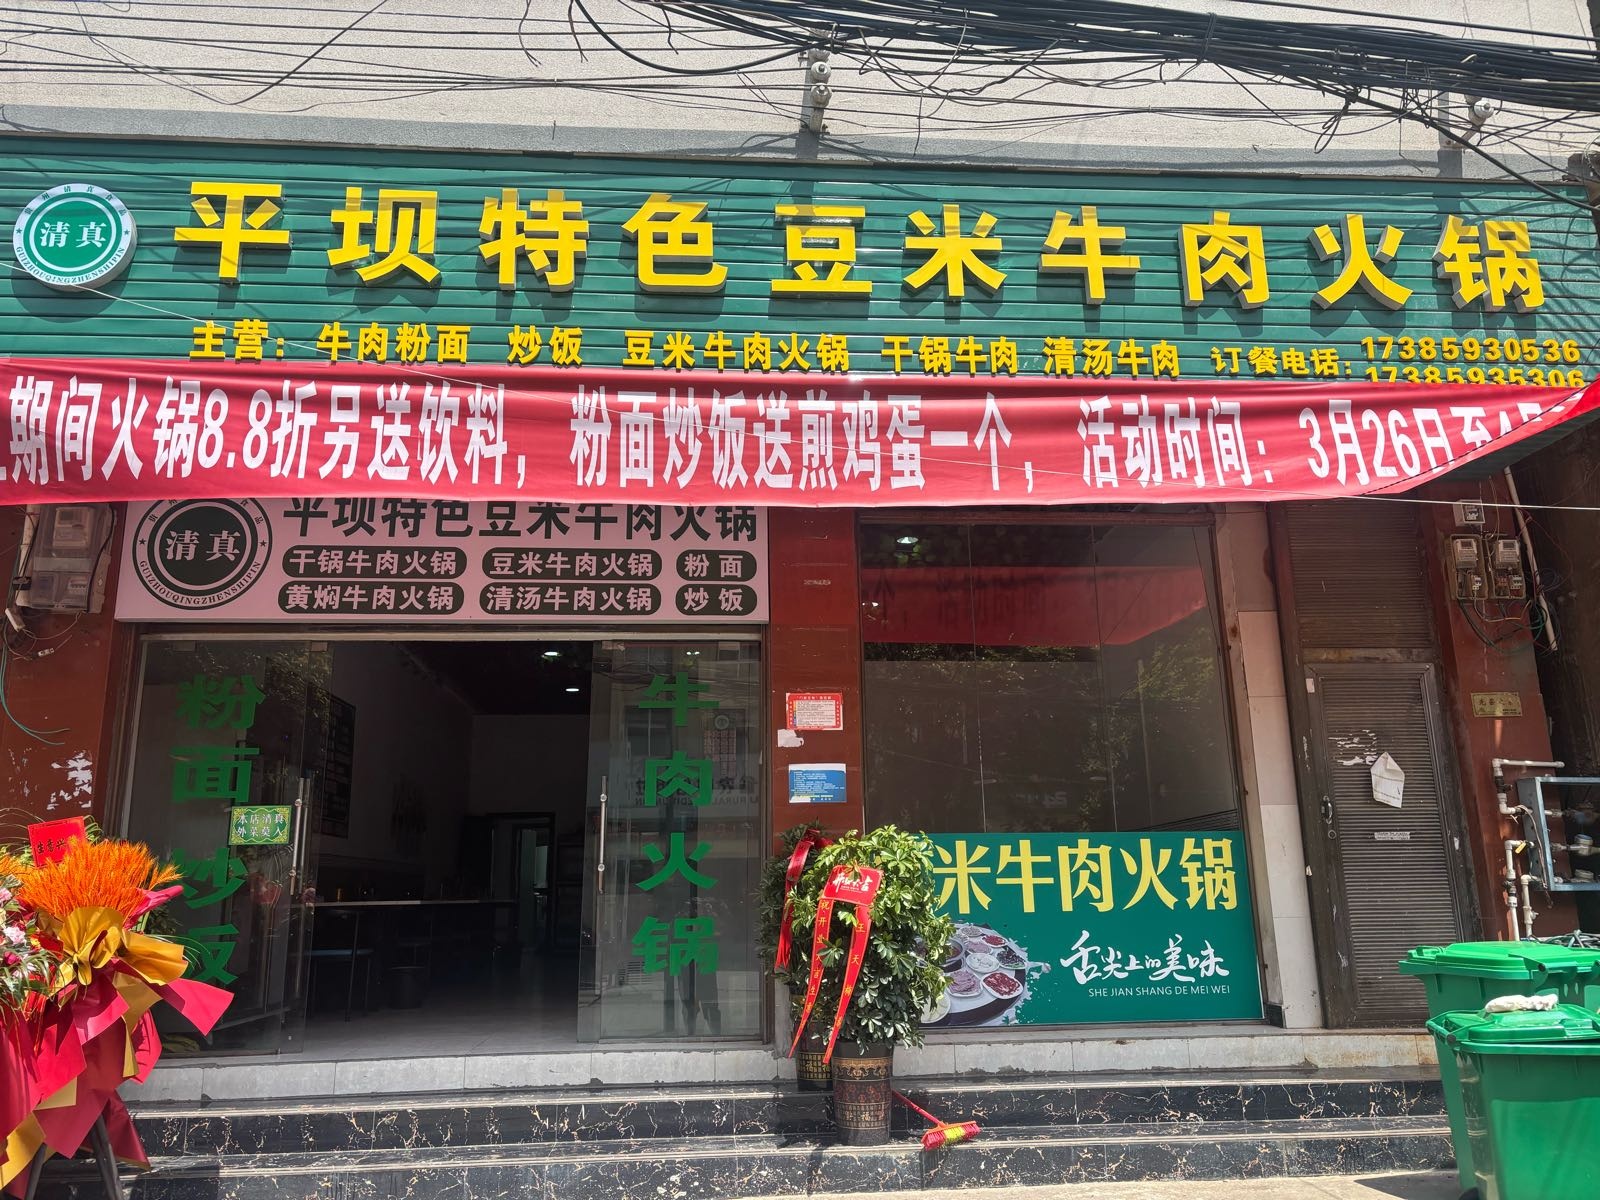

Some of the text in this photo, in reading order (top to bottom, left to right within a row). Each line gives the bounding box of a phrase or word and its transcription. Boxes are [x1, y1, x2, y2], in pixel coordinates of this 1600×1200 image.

[40, 221, 107, 248] 清真
[174, 180, 1546, 313] 平坝特色豆米牛肉火锅
[16, 246, 126, 284] GUIZHOUQINGZHENSHIPIN
[315, 321, 471, 364] 牛肉粉面
[507, 324, 584, 365] 炒饭
[622, 329, 850, 373] 豆米牛肉火锅
[880, 335, 1018, 377] 干锅牛肉
[1043, 336, 1181, 378] 清汤牛肉
[1361, 336, 1582, 363] 17385930536
[1365, 366, 1586, 388] 17385935306
[0, 374, 527, 489] 期间火锅8.8折另送饮料，
[283, 497, 757, 542] 平坝特色豆米牛肉火锅
[165, 529, 241, 561] 清真
[289, 549, 744, 579] 干锅牛肉火锅 豆米牛肉火锅 粉面
[139, 560, 262, 606] GUIZHOUQINGZHENSHIPIN
[285, 585, 744, 614] 黄焖牛肉火锅 清汤牛肉火锅 炒饭
[237, 813, 284, 825] 本店清真
[631, 671, 721, 977] 牛肉火锅
[932, 837, 1238, 915] 米牛肉火锅
[1059, 930, 1230, 985] 舌尖上的美味
[1088, 984, 1230, 998] SHE JIAN SHANG DE MEI WEI
